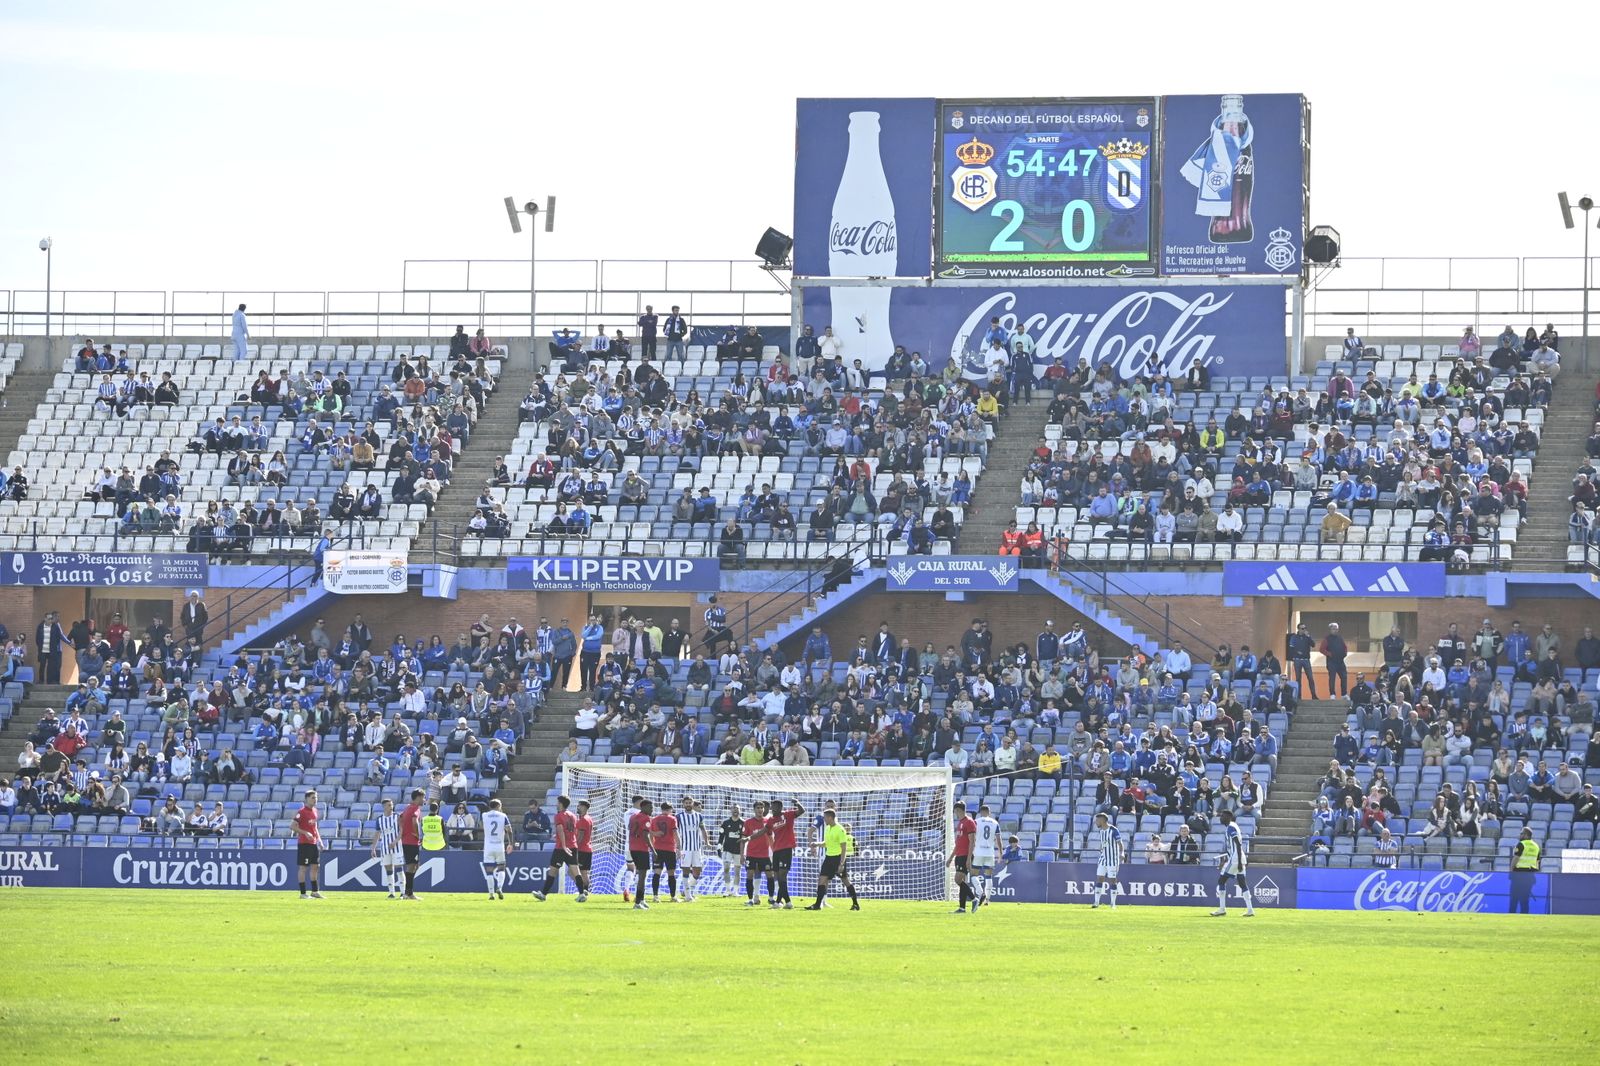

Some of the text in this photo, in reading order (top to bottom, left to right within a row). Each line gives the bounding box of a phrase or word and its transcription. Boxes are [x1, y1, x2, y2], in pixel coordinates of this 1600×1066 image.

[970, 112, 1124, 125] DECANO DEL FÚTBOL ESPAÑOL
[1006, 149, 1098, 178] 54:47
[989, 199, 1025, 252] 2
[1061, 199, 1095, 252] 0
[830, 220, 896, 256] Coca-Cola
[1165, 245, 1194, 255] Refresco
[1195, 245, 1216, 254] Oficial
[1165, 255, 1246, 266] R.C. Recreativo de Huelva
[989, 265, 1105, 277] www.alosonido.net
[41, 553, 152, 564] Bar Restaurante
[532, 559, 694, 581] KLIPERVIP
[917, 561, 987, 572] CAJA RURAL
[41, 565, 153, 585] Juan José
[934, 577, 971, 585] DEL SUR
[581, 582, 601, 591] High
[604, 582, 652, 591] Technology
[490, 821, 499, 836] 2
[983, 825, 991, 840] 8
[0, 851, 59, 871] URAL
[113, 850, 287, 890] Cruzcampo
[1353, 869, 1493, 912] Coca-Cola
